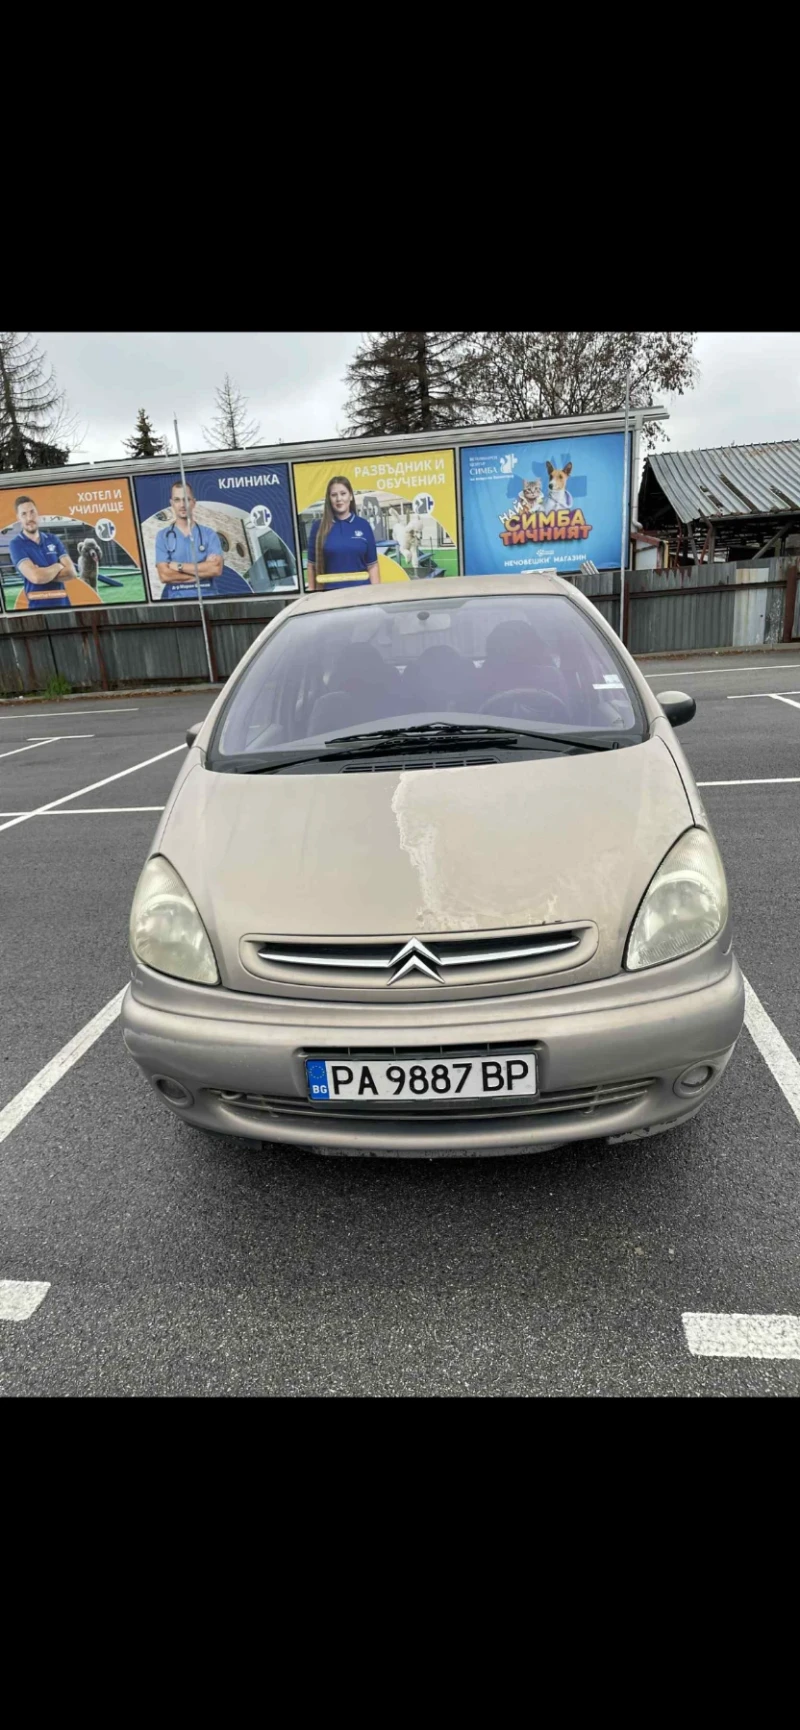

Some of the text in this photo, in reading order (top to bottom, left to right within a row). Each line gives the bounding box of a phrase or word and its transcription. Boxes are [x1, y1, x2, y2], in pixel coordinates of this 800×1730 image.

[354, 458, 445, 477] РАЗВЪДНИК И
[469, 467, 498, 475] СИМБА
[218, 473, 280, 489] КЛИНИКА
[376, 473, 446, 490] ОБУЧЕНИЯ
[77, 489, 122, 503] ХОТЕЛ И
[69, 501, 124, 515] УЧИЛИЩЕ
[504, 509, 587, 532] СИМБА
[500, 525, 593, 546] ТИЧНИЯТ
[553, 554, 587, 563] МАГАЗИН
[331, 1060, 529, 1095] PA 9887 BP
[312, 1085, 328, 1094] BG
